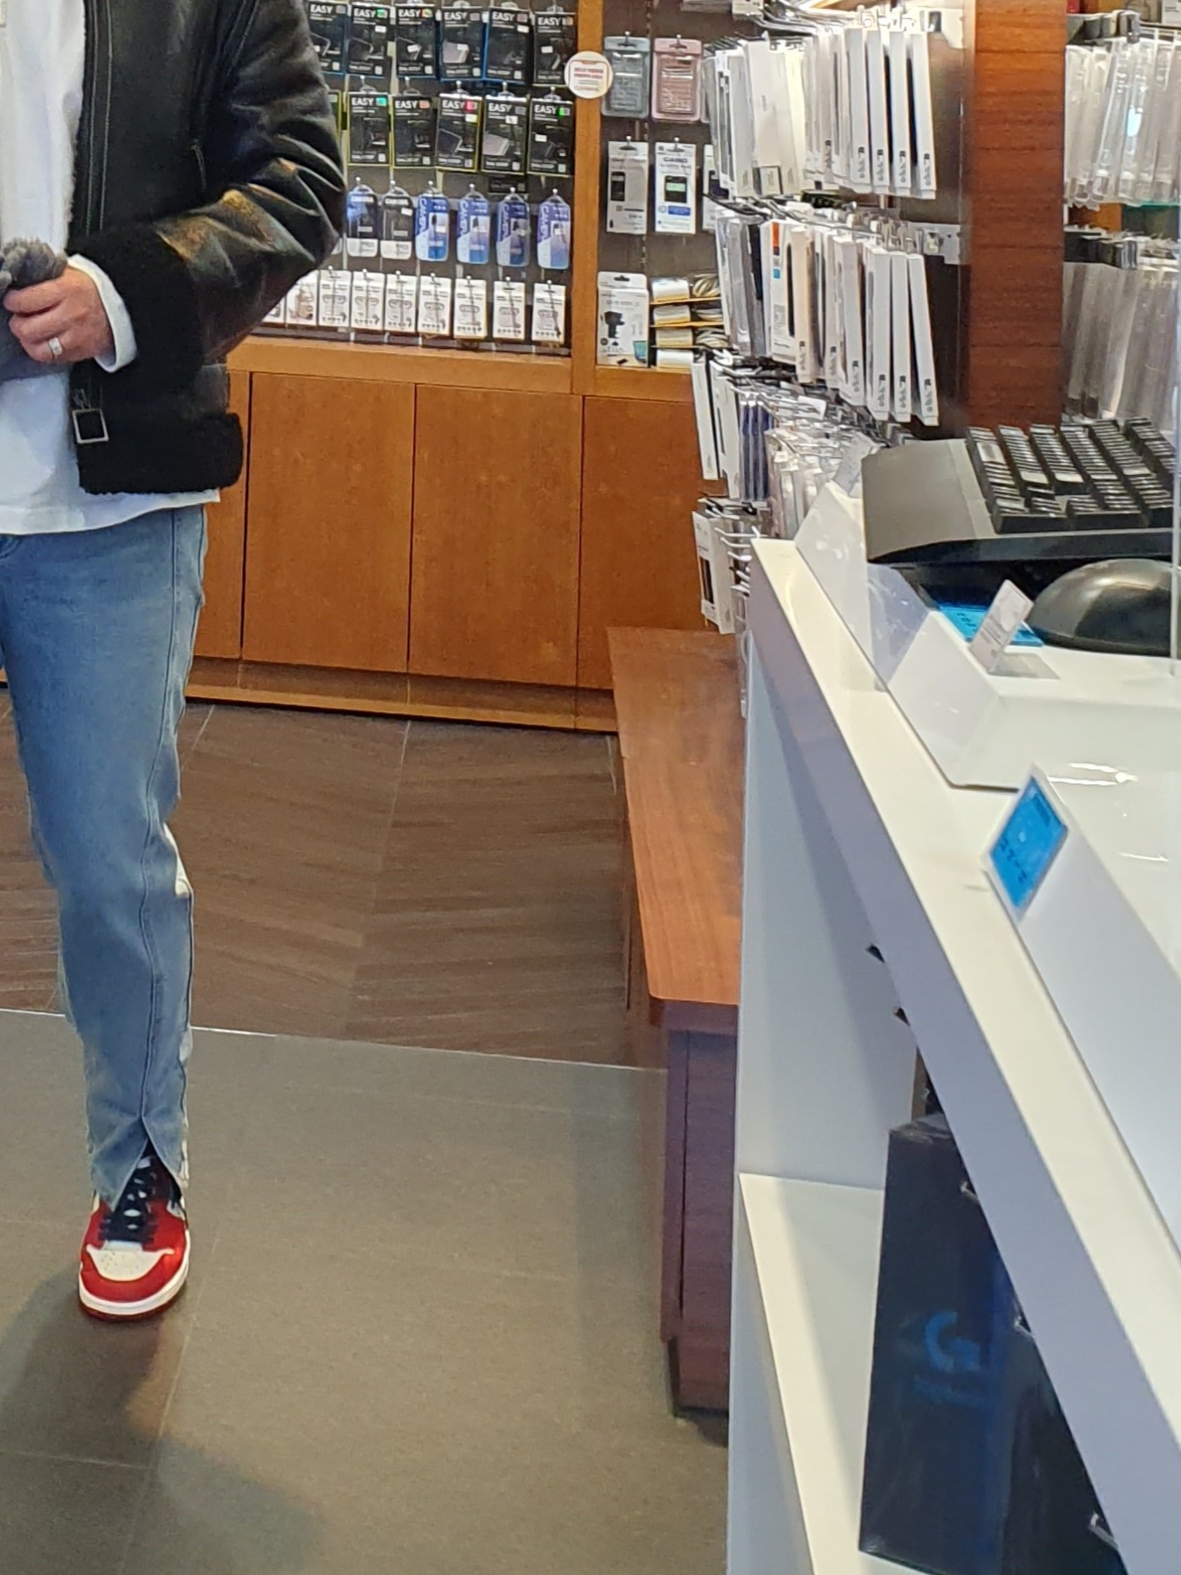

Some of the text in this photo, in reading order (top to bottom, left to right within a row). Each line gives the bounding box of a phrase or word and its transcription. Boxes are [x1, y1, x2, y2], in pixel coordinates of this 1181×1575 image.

[310, 4, 333, 14] EASY
[353, 8, 376, 18] EASY
[398, 8, 421, 18] EASY
[444, 11, 468, 20] EASY
[492, 10, 515, 21] EASY
[538, 16, 561, 26] EASY
[351, 97, 374, 106] EASY
[395, 100, 418, 109] EASY
[442, 99, 465, 109] EASY
[488, 103, 512, 112] EASY
[534, 104, 557, 114] EASY
